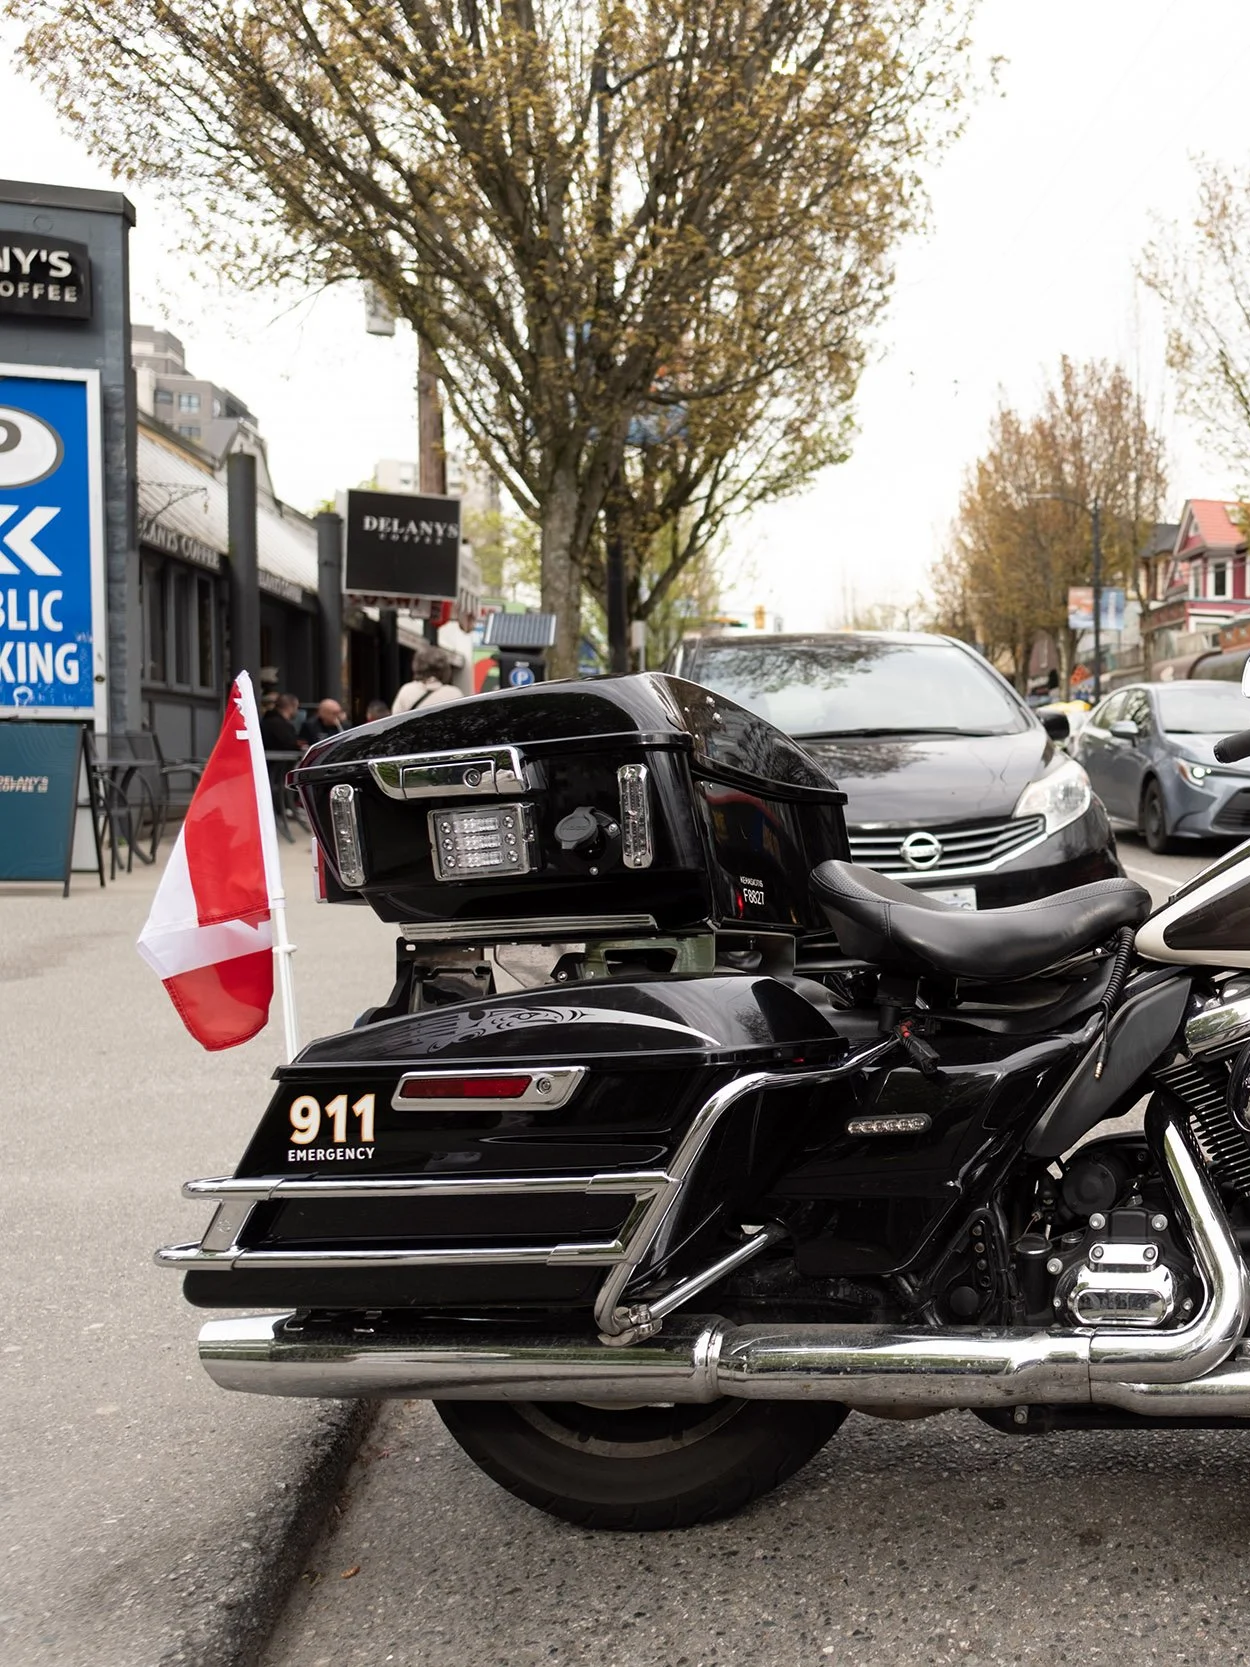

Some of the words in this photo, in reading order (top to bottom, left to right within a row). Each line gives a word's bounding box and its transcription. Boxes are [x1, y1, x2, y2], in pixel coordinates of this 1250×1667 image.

[0, 280, 78, 303] OFFEE
[363, 515, 460, 539] DELANYS
[379, 533, 443, 545] COFFEE
[743, 888, 765, 905] F8827
[289, 1093, 376, 1145] 911
[288, 1147, 375, 1162] EMERGENCY
